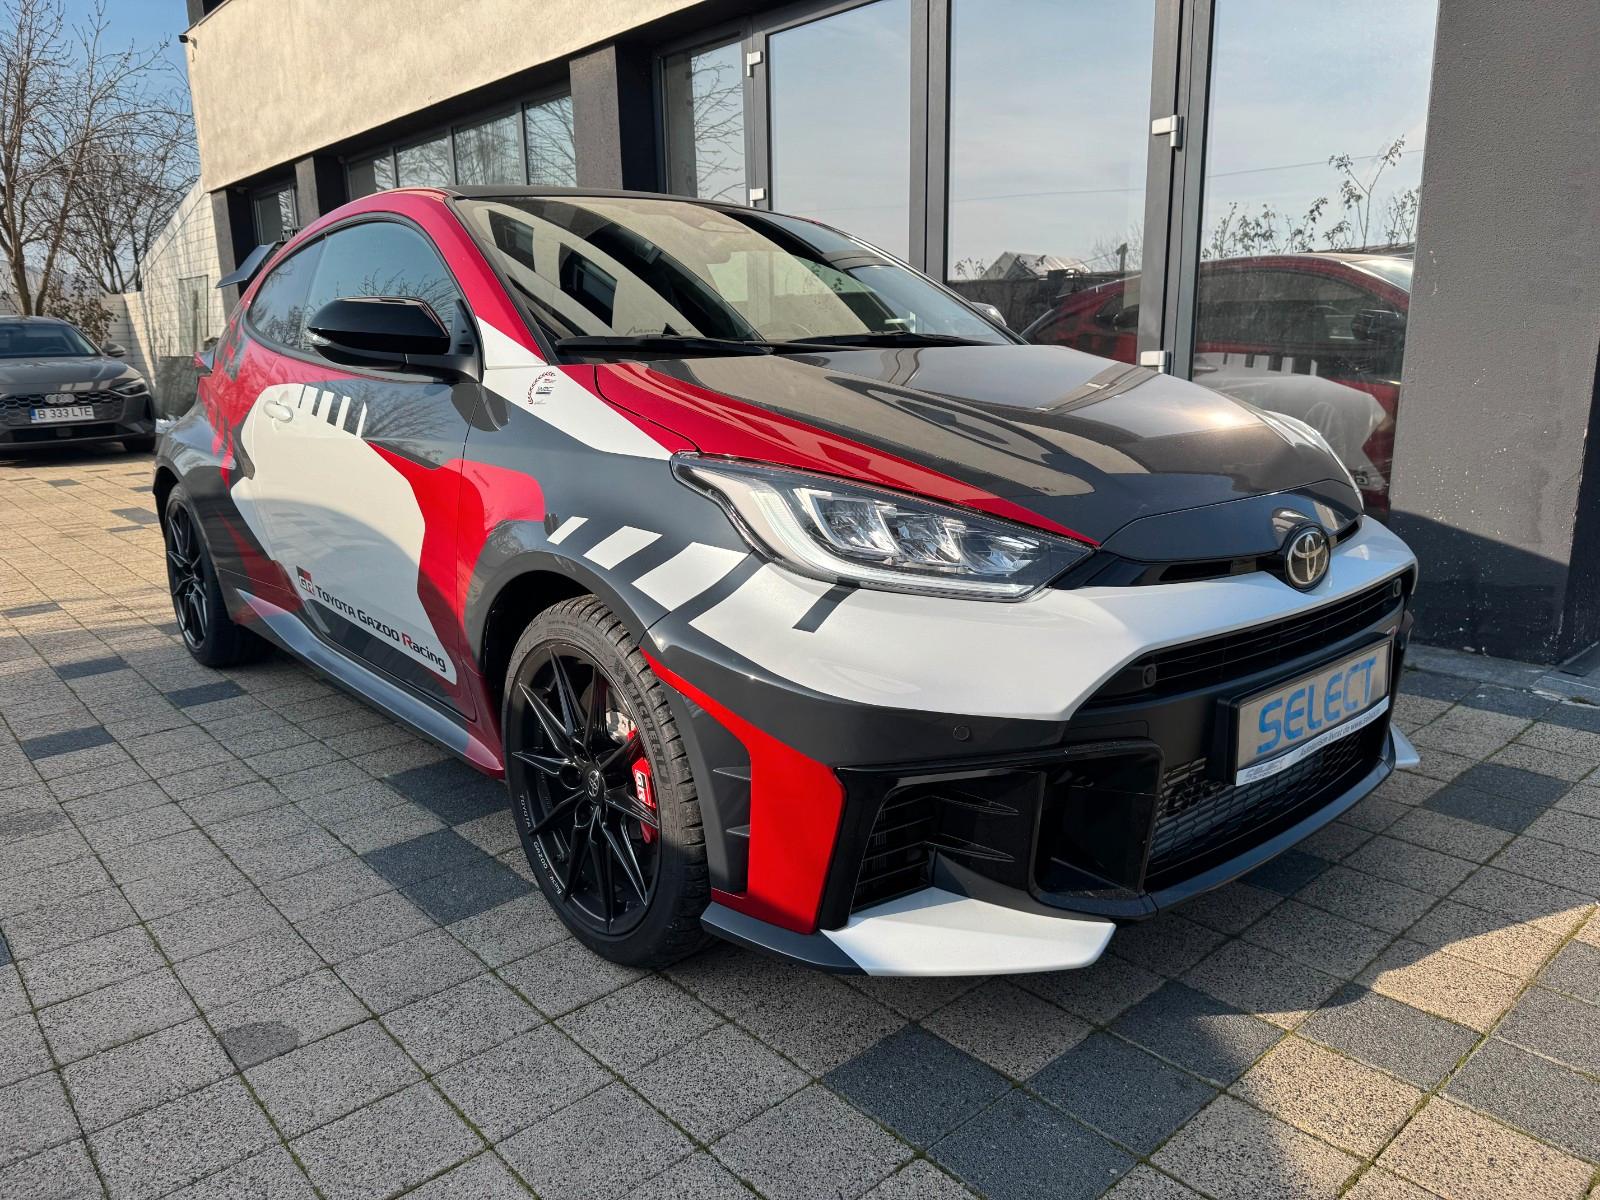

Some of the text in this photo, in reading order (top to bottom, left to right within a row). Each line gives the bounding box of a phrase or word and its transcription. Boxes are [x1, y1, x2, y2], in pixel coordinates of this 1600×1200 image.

[38, 406, 92, 419] B 333 LTE
[299, 577, 315, 594] GR
[315, 585, 447, 673] TOYOTA GAZOO Racing
[1256, 656, 1376, 754] SELECT
[625, 680, 672, 785] MICHELIN
[519, 794, 533, 829] TOYOTA
[533, 841, 548, 869] GAZOO
